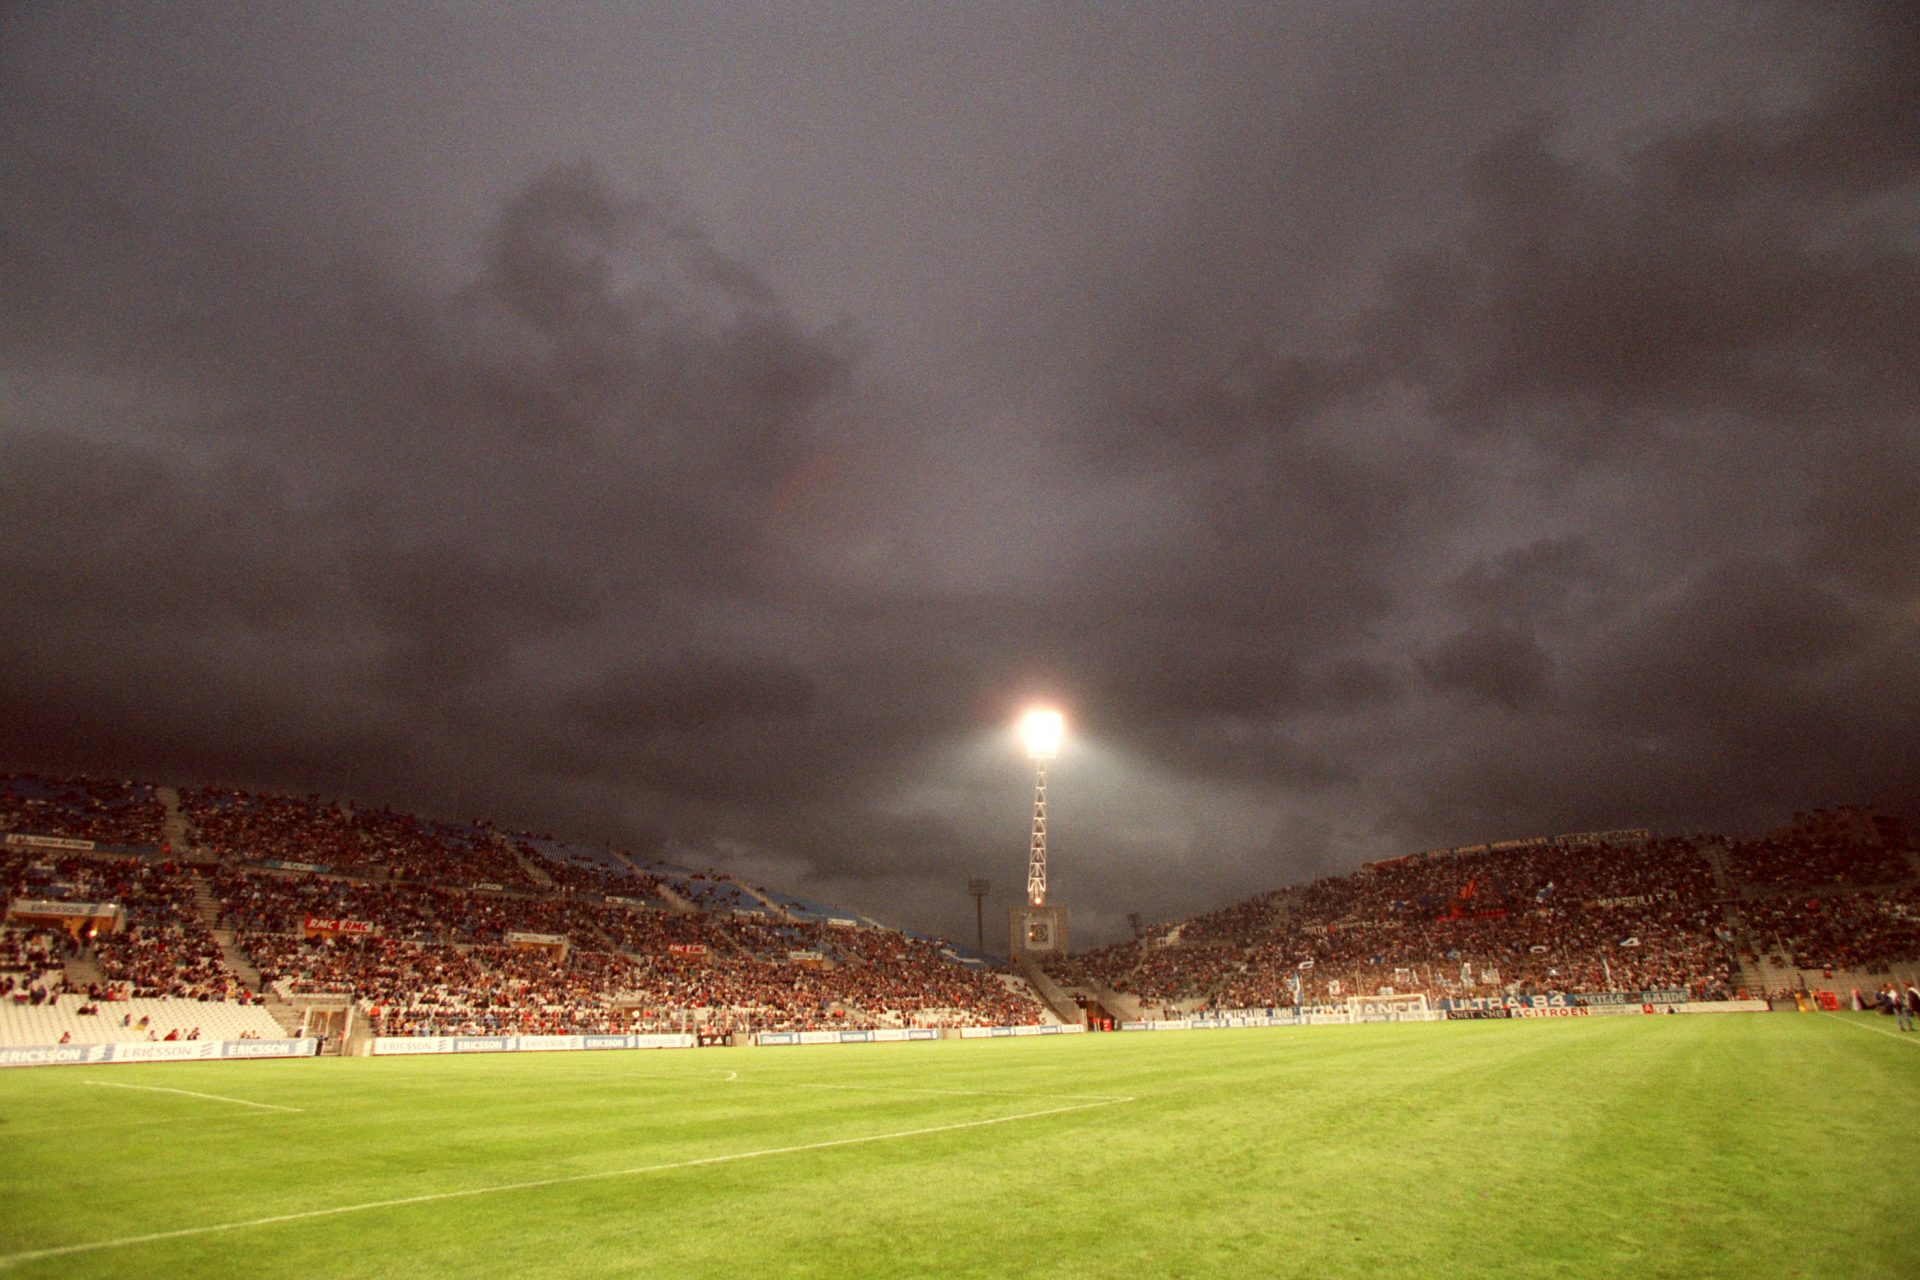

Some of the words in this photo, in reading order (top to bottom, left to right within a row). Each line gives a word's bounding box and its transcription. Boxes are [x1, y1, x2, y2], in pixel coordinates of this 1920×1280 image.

[31, 904, 81, 914] ERICSSON
[308, 918, 336, 929] RMC
[344, 921, 370, 930] RMC
[1450, 996, 1522, 1010] ULTRA
[1531, 994, 1566, 1007] 84
[1643, 991, 1686, 1003] GARDE
[228, 1043, 289, 1055] ERICSSON
[384, 1042, 431, 1051] ERICSSON
[458, 1041, 502, 1050] ERICSSON
[123, 1047, 191, 1058] ERICSSON
